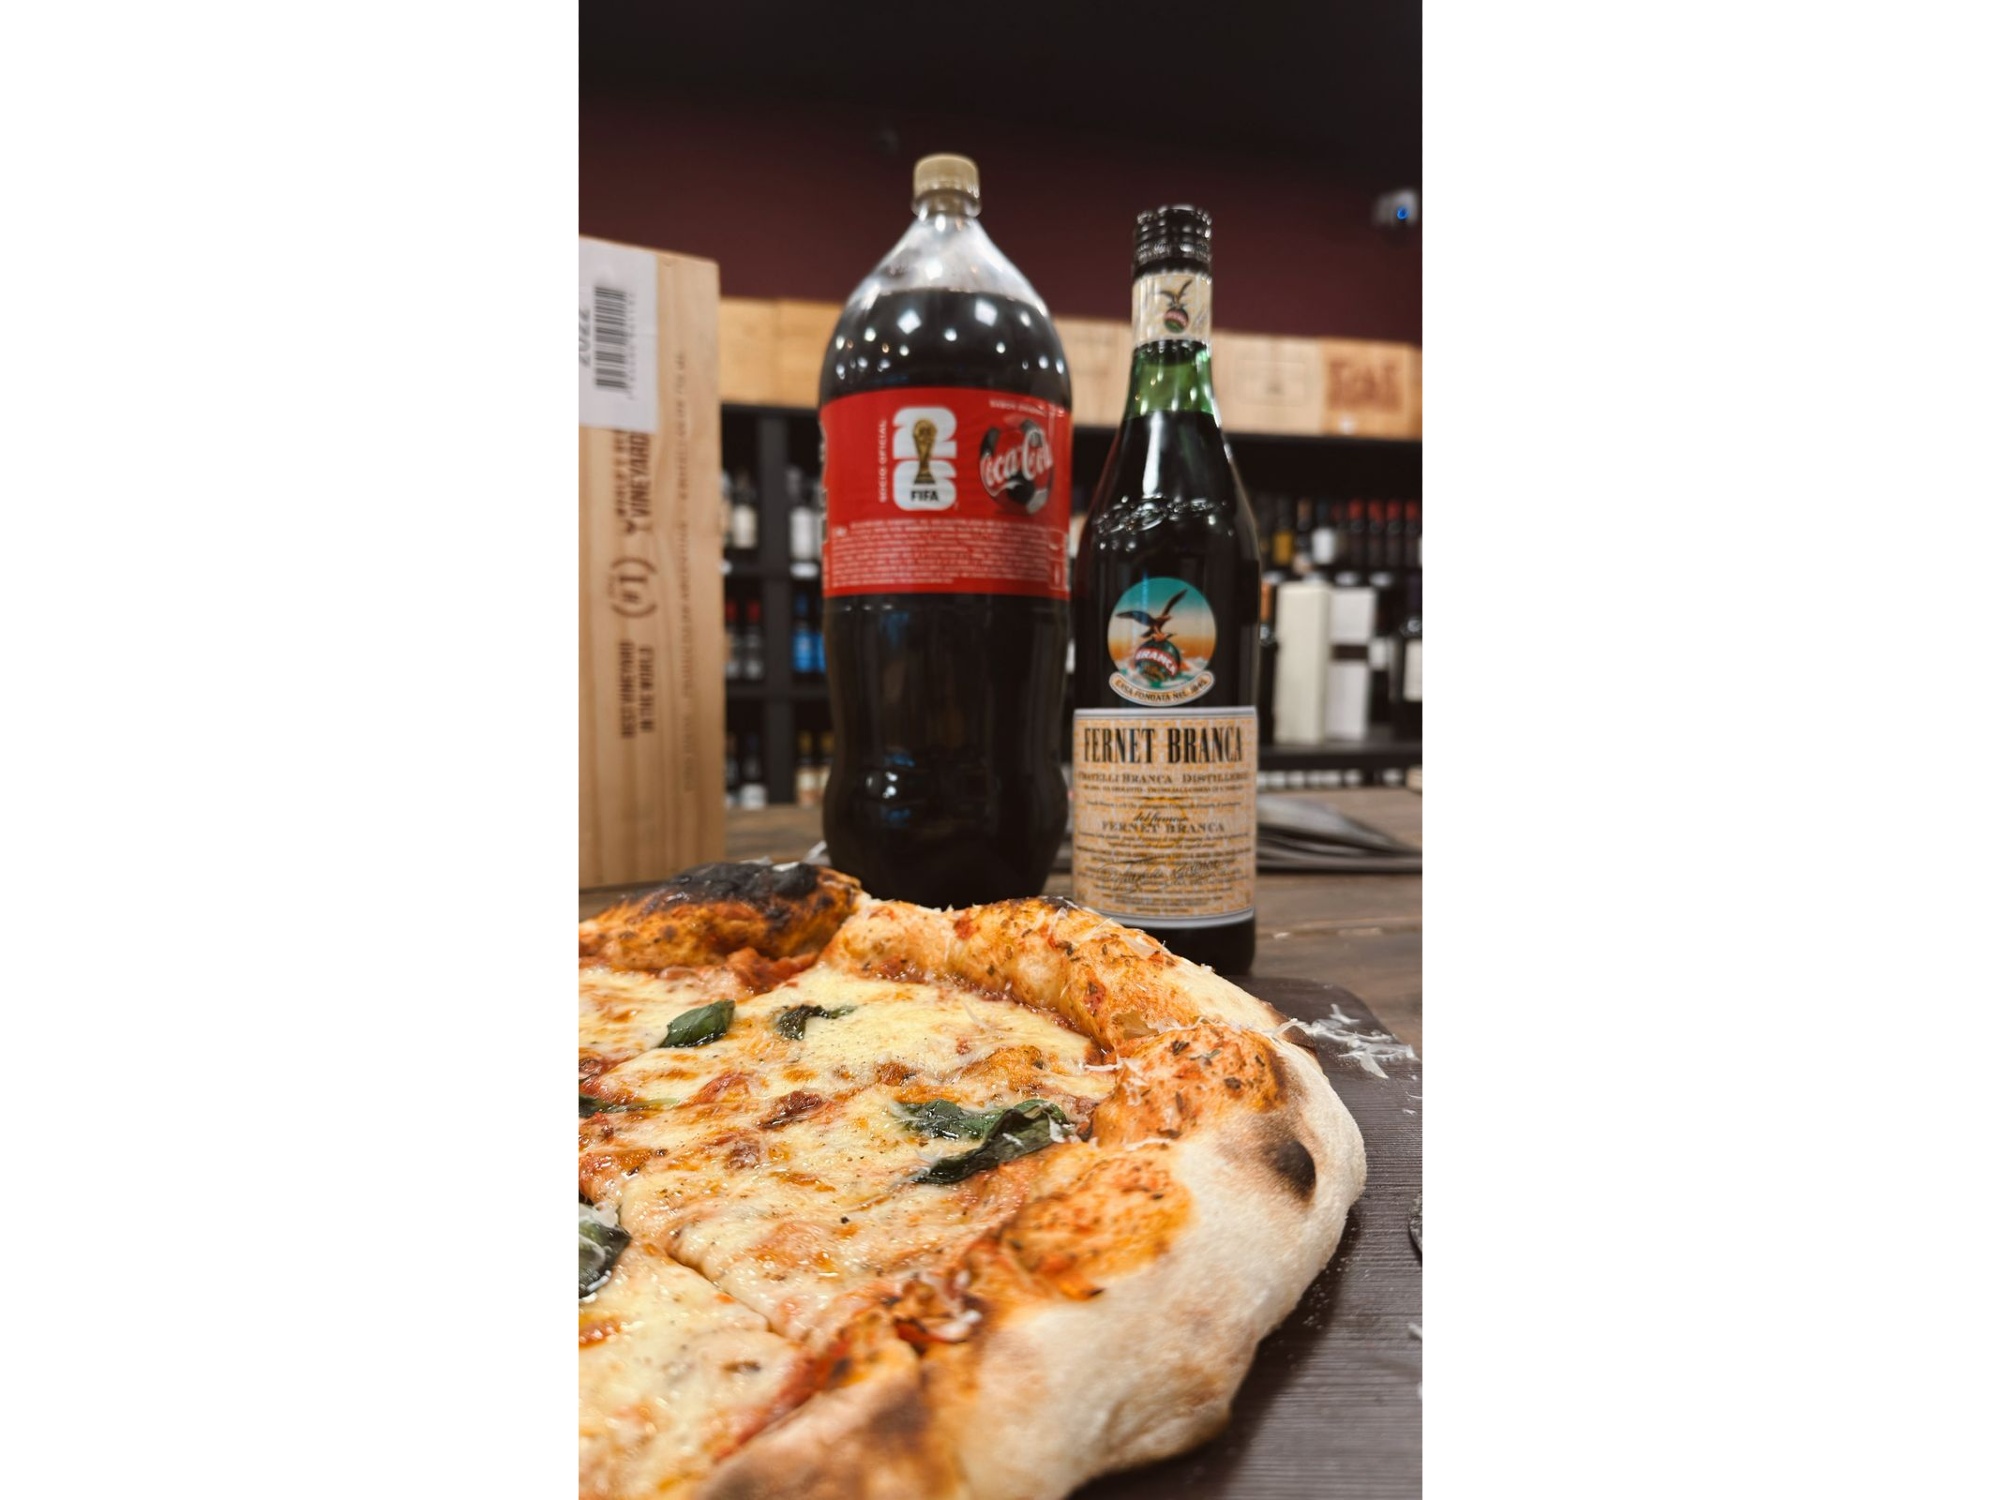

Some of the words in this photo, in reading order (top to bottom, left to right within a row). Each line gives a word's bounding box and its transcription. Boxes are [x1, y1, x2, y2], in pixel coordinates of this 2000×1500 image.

[878, 420, 888, 464] OFICIAL
[878, 466, 888, 503] SOCIO
[911, 490, 940, 501] FIFA
[1115, 679, 1133, 696] CASA
[1134, 690, 1171, 701] FONDATA
[1084, 727, 1155, 764] FERNET
[1167, 726, 1242, 764] BRANCA
[1122, 772, 1173, 784] BRANCA
[1102, 821, 1160, 833] FERNET
[1166, 822, 1225, 834] BRANCA
